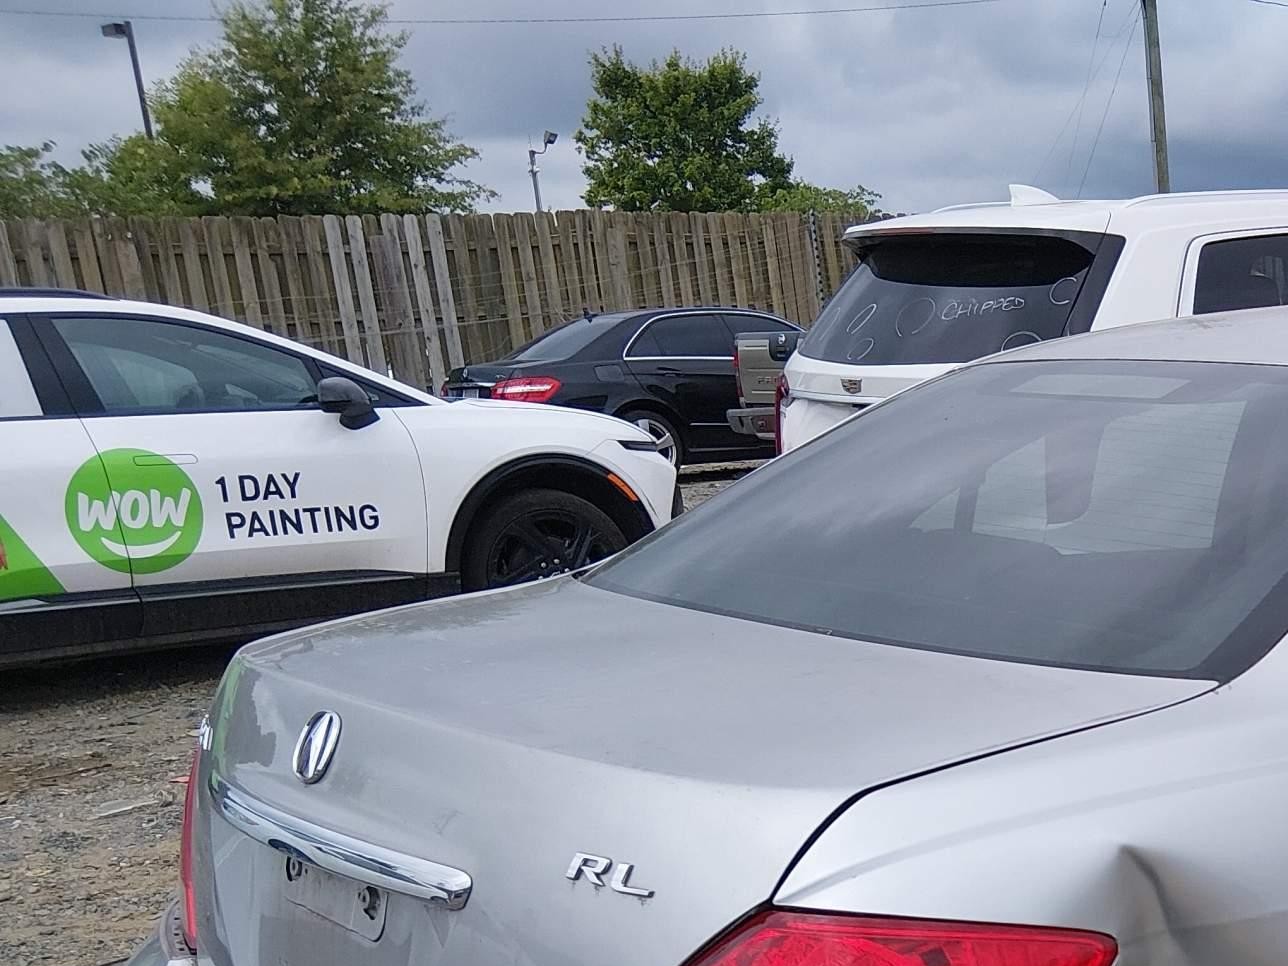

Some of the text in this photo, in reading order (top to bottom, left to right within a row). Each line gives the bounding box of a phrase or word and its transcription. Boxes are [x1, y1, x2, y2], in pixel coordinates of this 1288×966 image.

[941, 296, 1025, 320] CHIPPED
[215, 472, 300, 502] 1 DAY
[78, 488, 191, 532] WOW
[225, 504, 380, 539] PAINTING
[566, 851, 655, 898] RL
